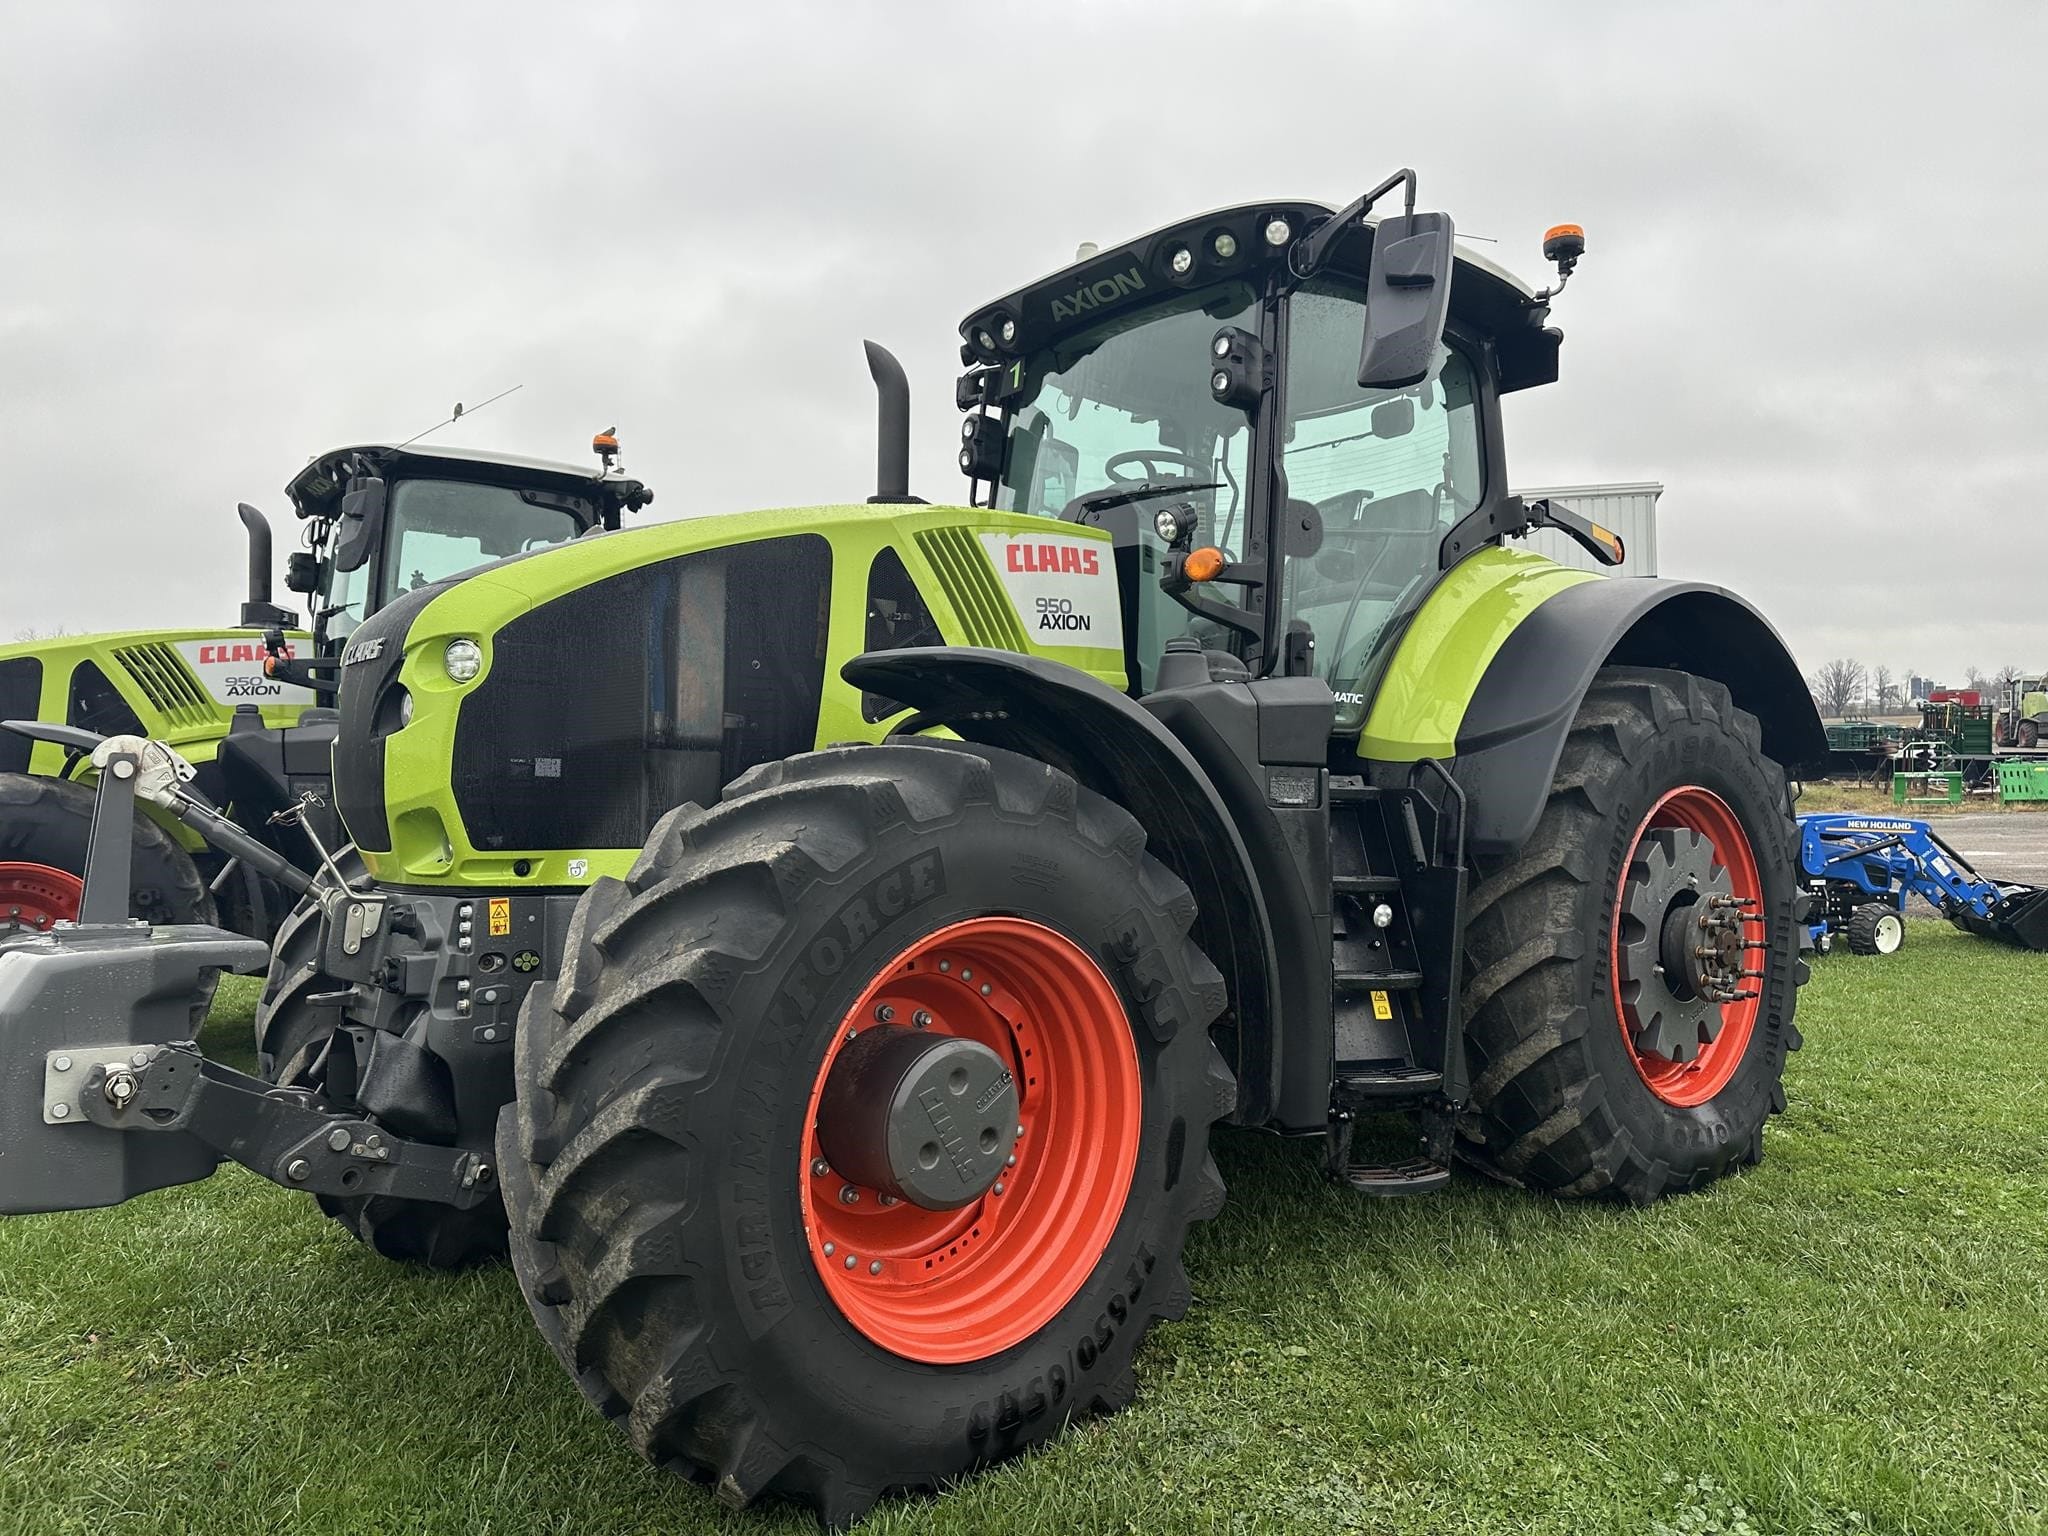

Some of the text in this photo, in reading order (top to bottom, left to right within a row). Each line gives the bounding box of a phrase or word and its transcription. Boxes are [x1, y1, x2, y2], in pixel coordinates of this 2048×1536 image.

[1050, 267, 1147, 322] AXION
[1006, 544, 1099, 575] CLAAS
[1035, 597, 1073, 615] 950
[1039, 614, 1091, 631] AXION
[225, 676, 263, 687] 950
[226, 685, 281, 697] AXION
[1847, 821, 1912, 830] NEW HOLLAND
[782, 853, 938, 1018] FORCE
[1103, 907, 1191, 1044] BKT
